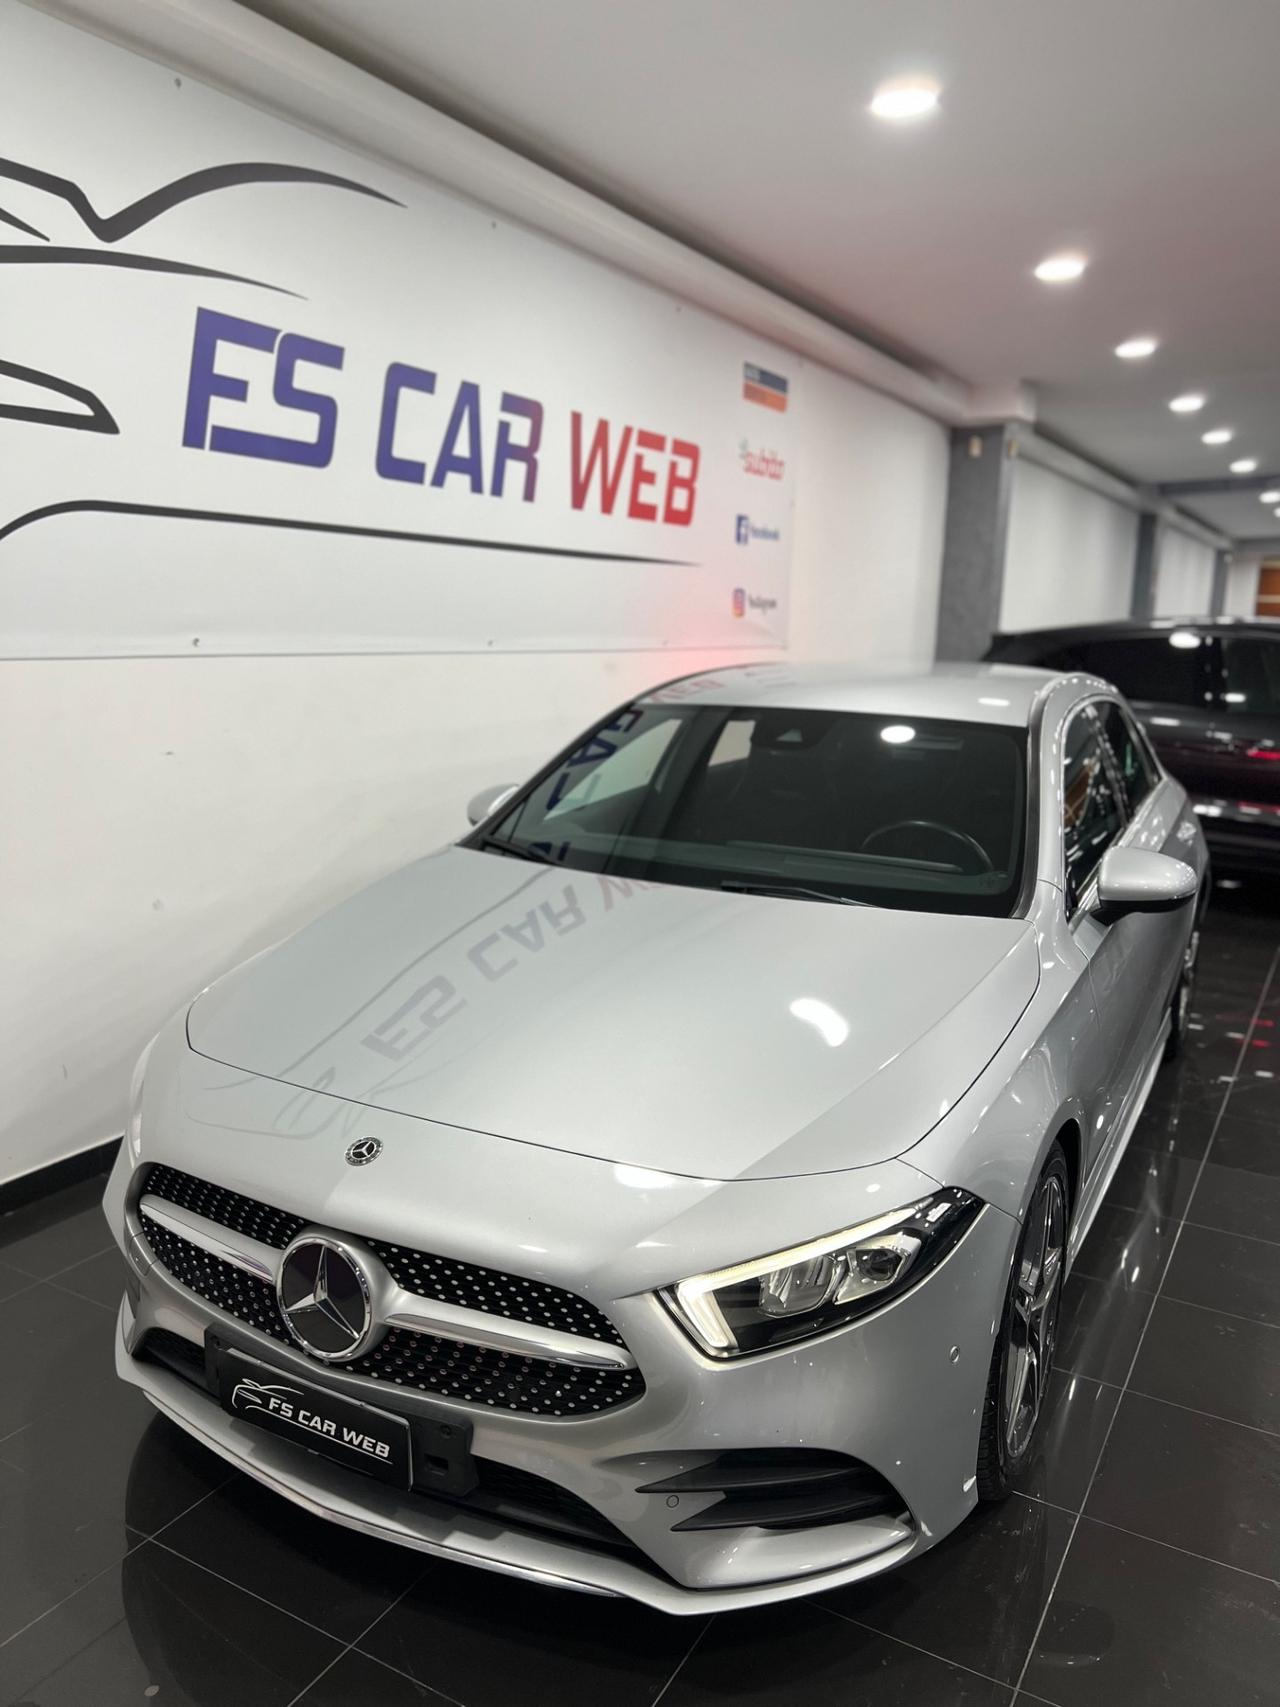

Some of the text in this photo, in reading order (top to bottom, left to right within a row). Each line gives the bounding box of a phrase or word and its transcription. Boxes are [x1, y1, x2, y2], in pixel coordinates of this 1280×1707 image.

[375, 361, 544, 503] CAR
[570, 410, 701, 527] WEB
[268, 1397, 390, 1458] FS CAR WEB
